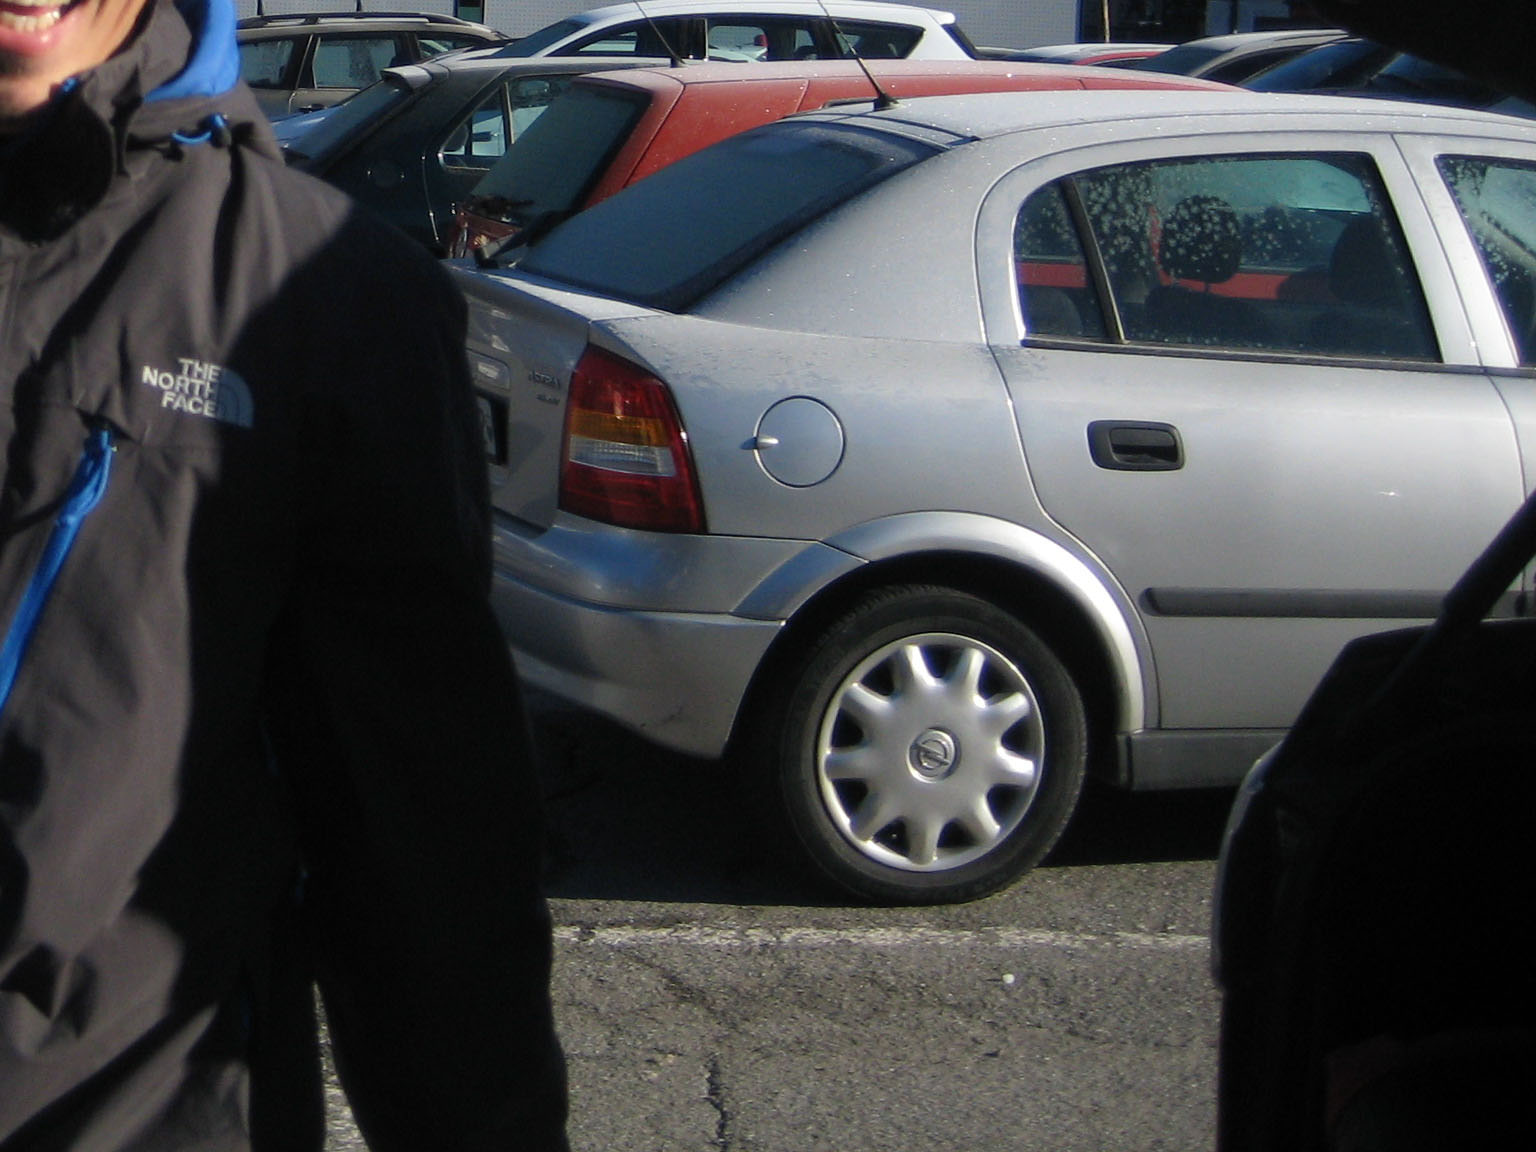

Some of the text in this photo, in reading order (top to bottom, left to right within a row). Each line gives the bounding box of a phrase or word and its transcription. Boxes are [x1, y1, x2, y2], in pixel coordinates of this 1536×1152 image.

[142, 365, 218, 399] NORTH
[178, 357, 222, 382] THE
[161, 390, 216, 417] FACE
